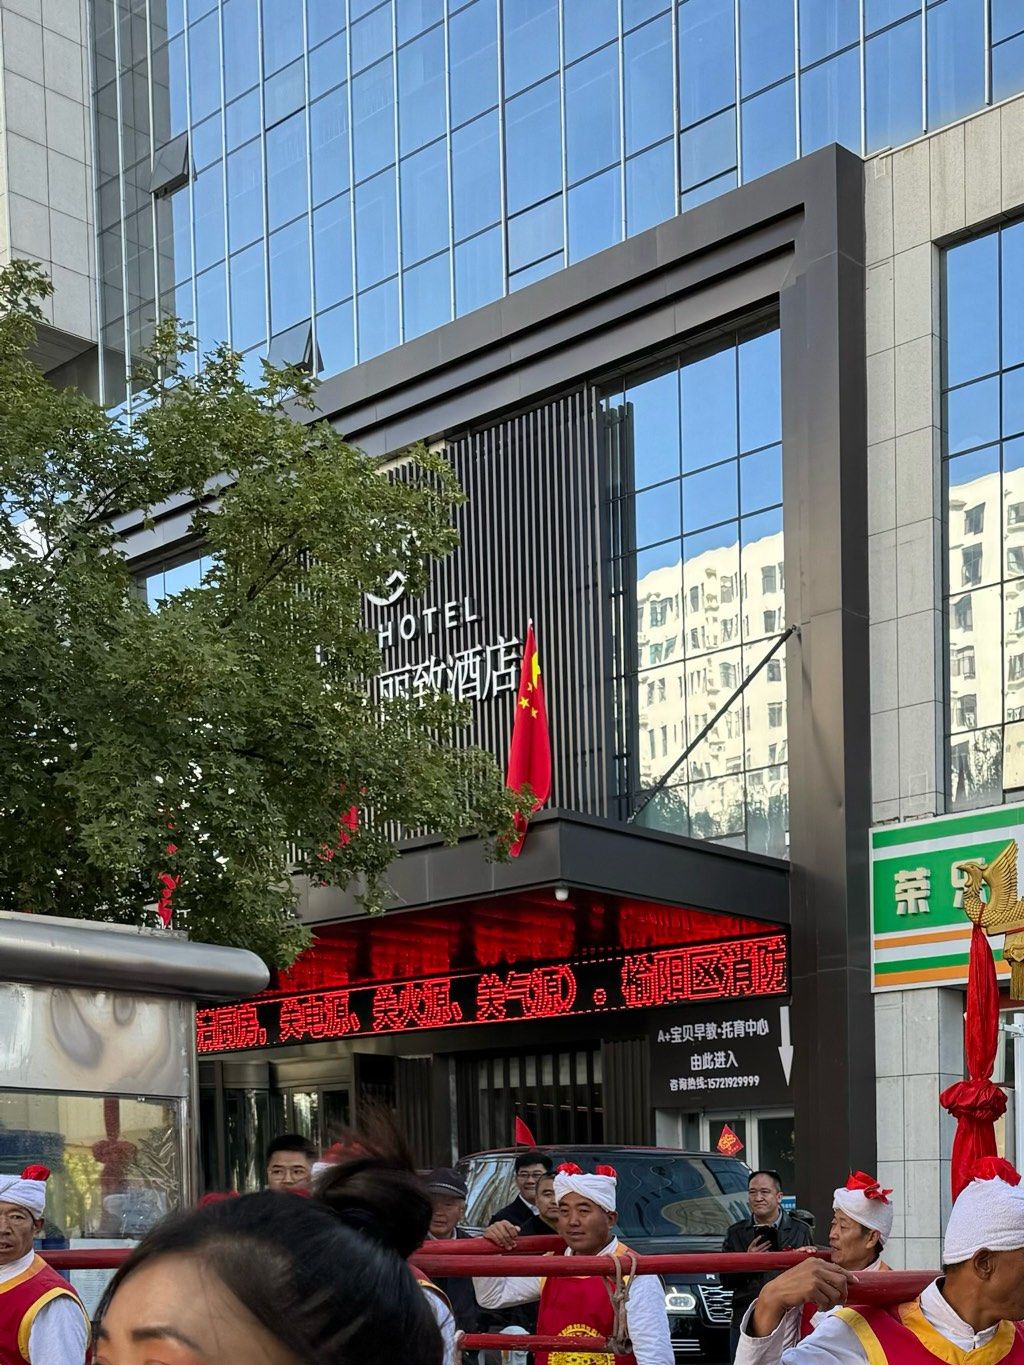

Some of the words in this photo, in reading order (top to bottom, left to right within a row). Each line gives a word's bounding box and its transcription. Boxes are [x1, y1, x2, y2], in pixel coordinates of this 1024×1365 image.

[378, 597, 480, 649] HOTEL
[690, 1050, 738, 1071] 由此进入
